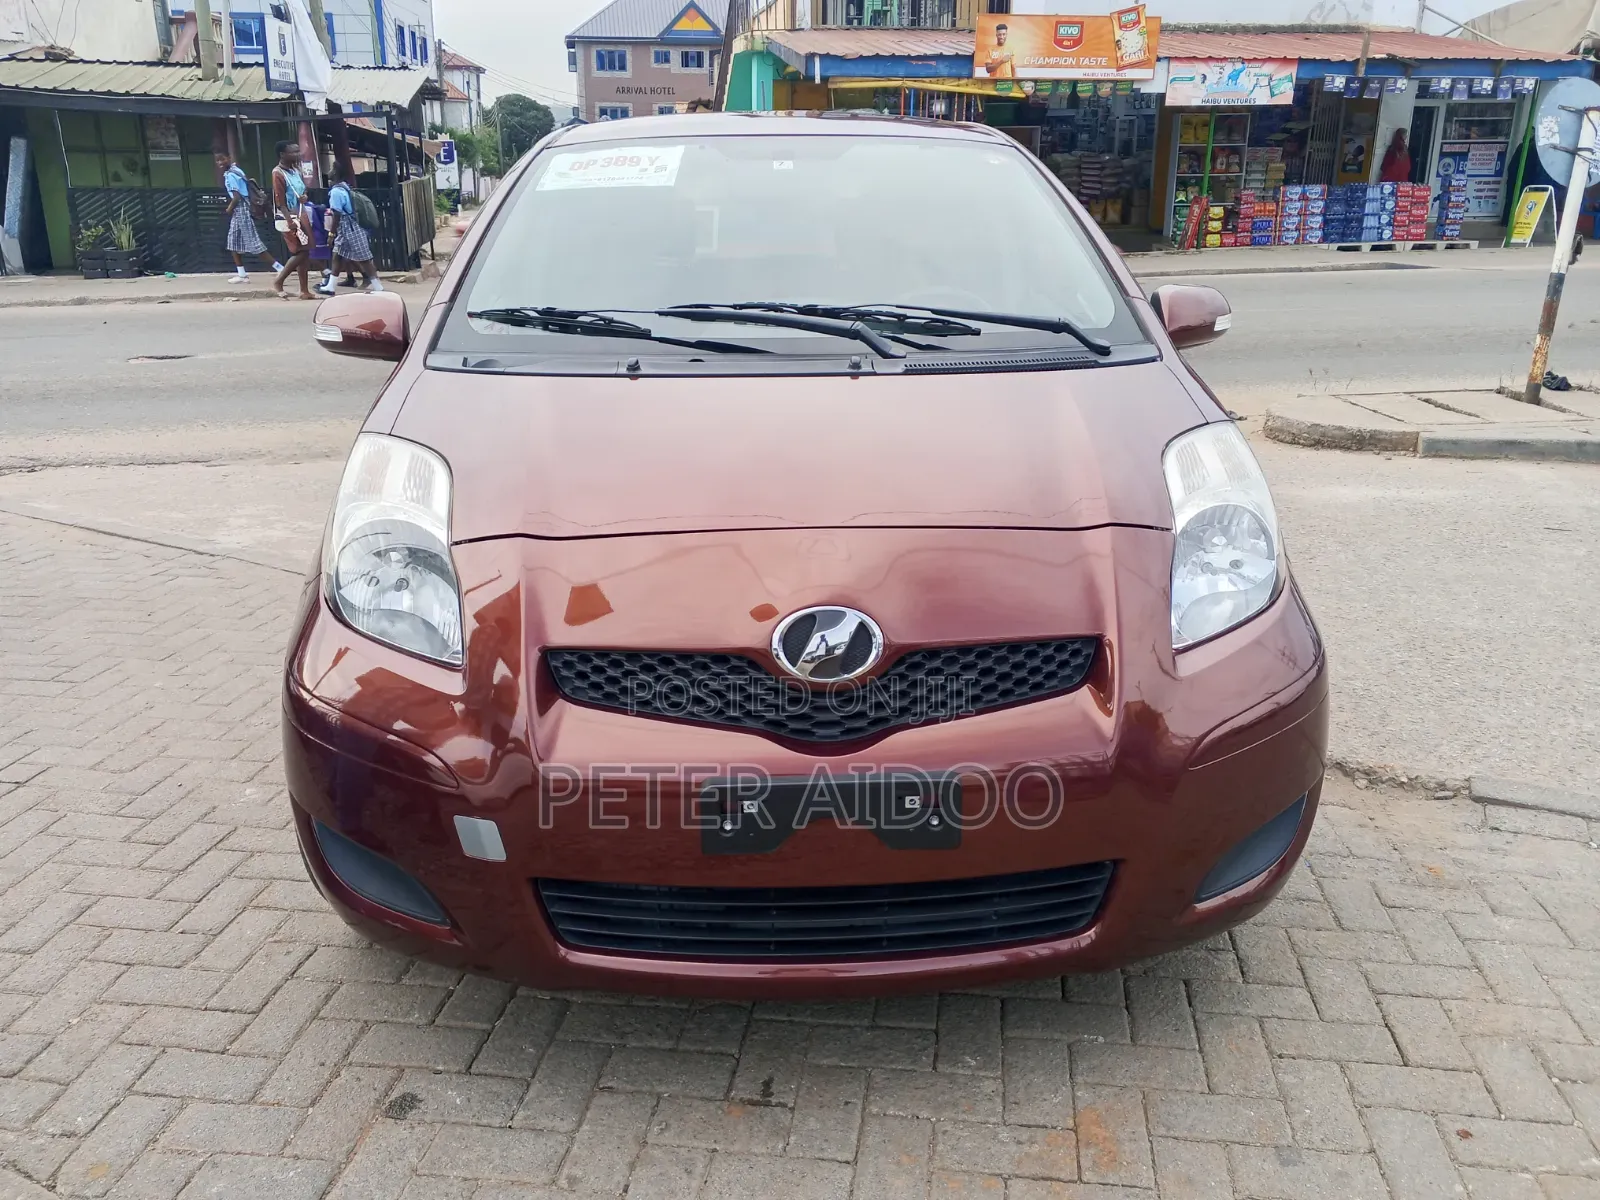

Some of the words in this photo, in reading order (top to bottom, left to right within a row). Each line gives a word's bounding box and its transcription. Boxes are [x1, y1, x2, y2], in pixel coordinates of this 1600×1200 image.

[1059, 26, 1079, 35] KIVO
[1024, 56, 1077, 66] CHAMPION
[1079, 57, 1109, 66] TASTE
[615, 86, 648, 95] ARRIVAL
[649, 86, 676, 95] HOTEL
[1201, 97, 1221, 105] HAIBU
[1223, 97, 1257, 105] VENTURES
[600, 155, 642, 168] 389
